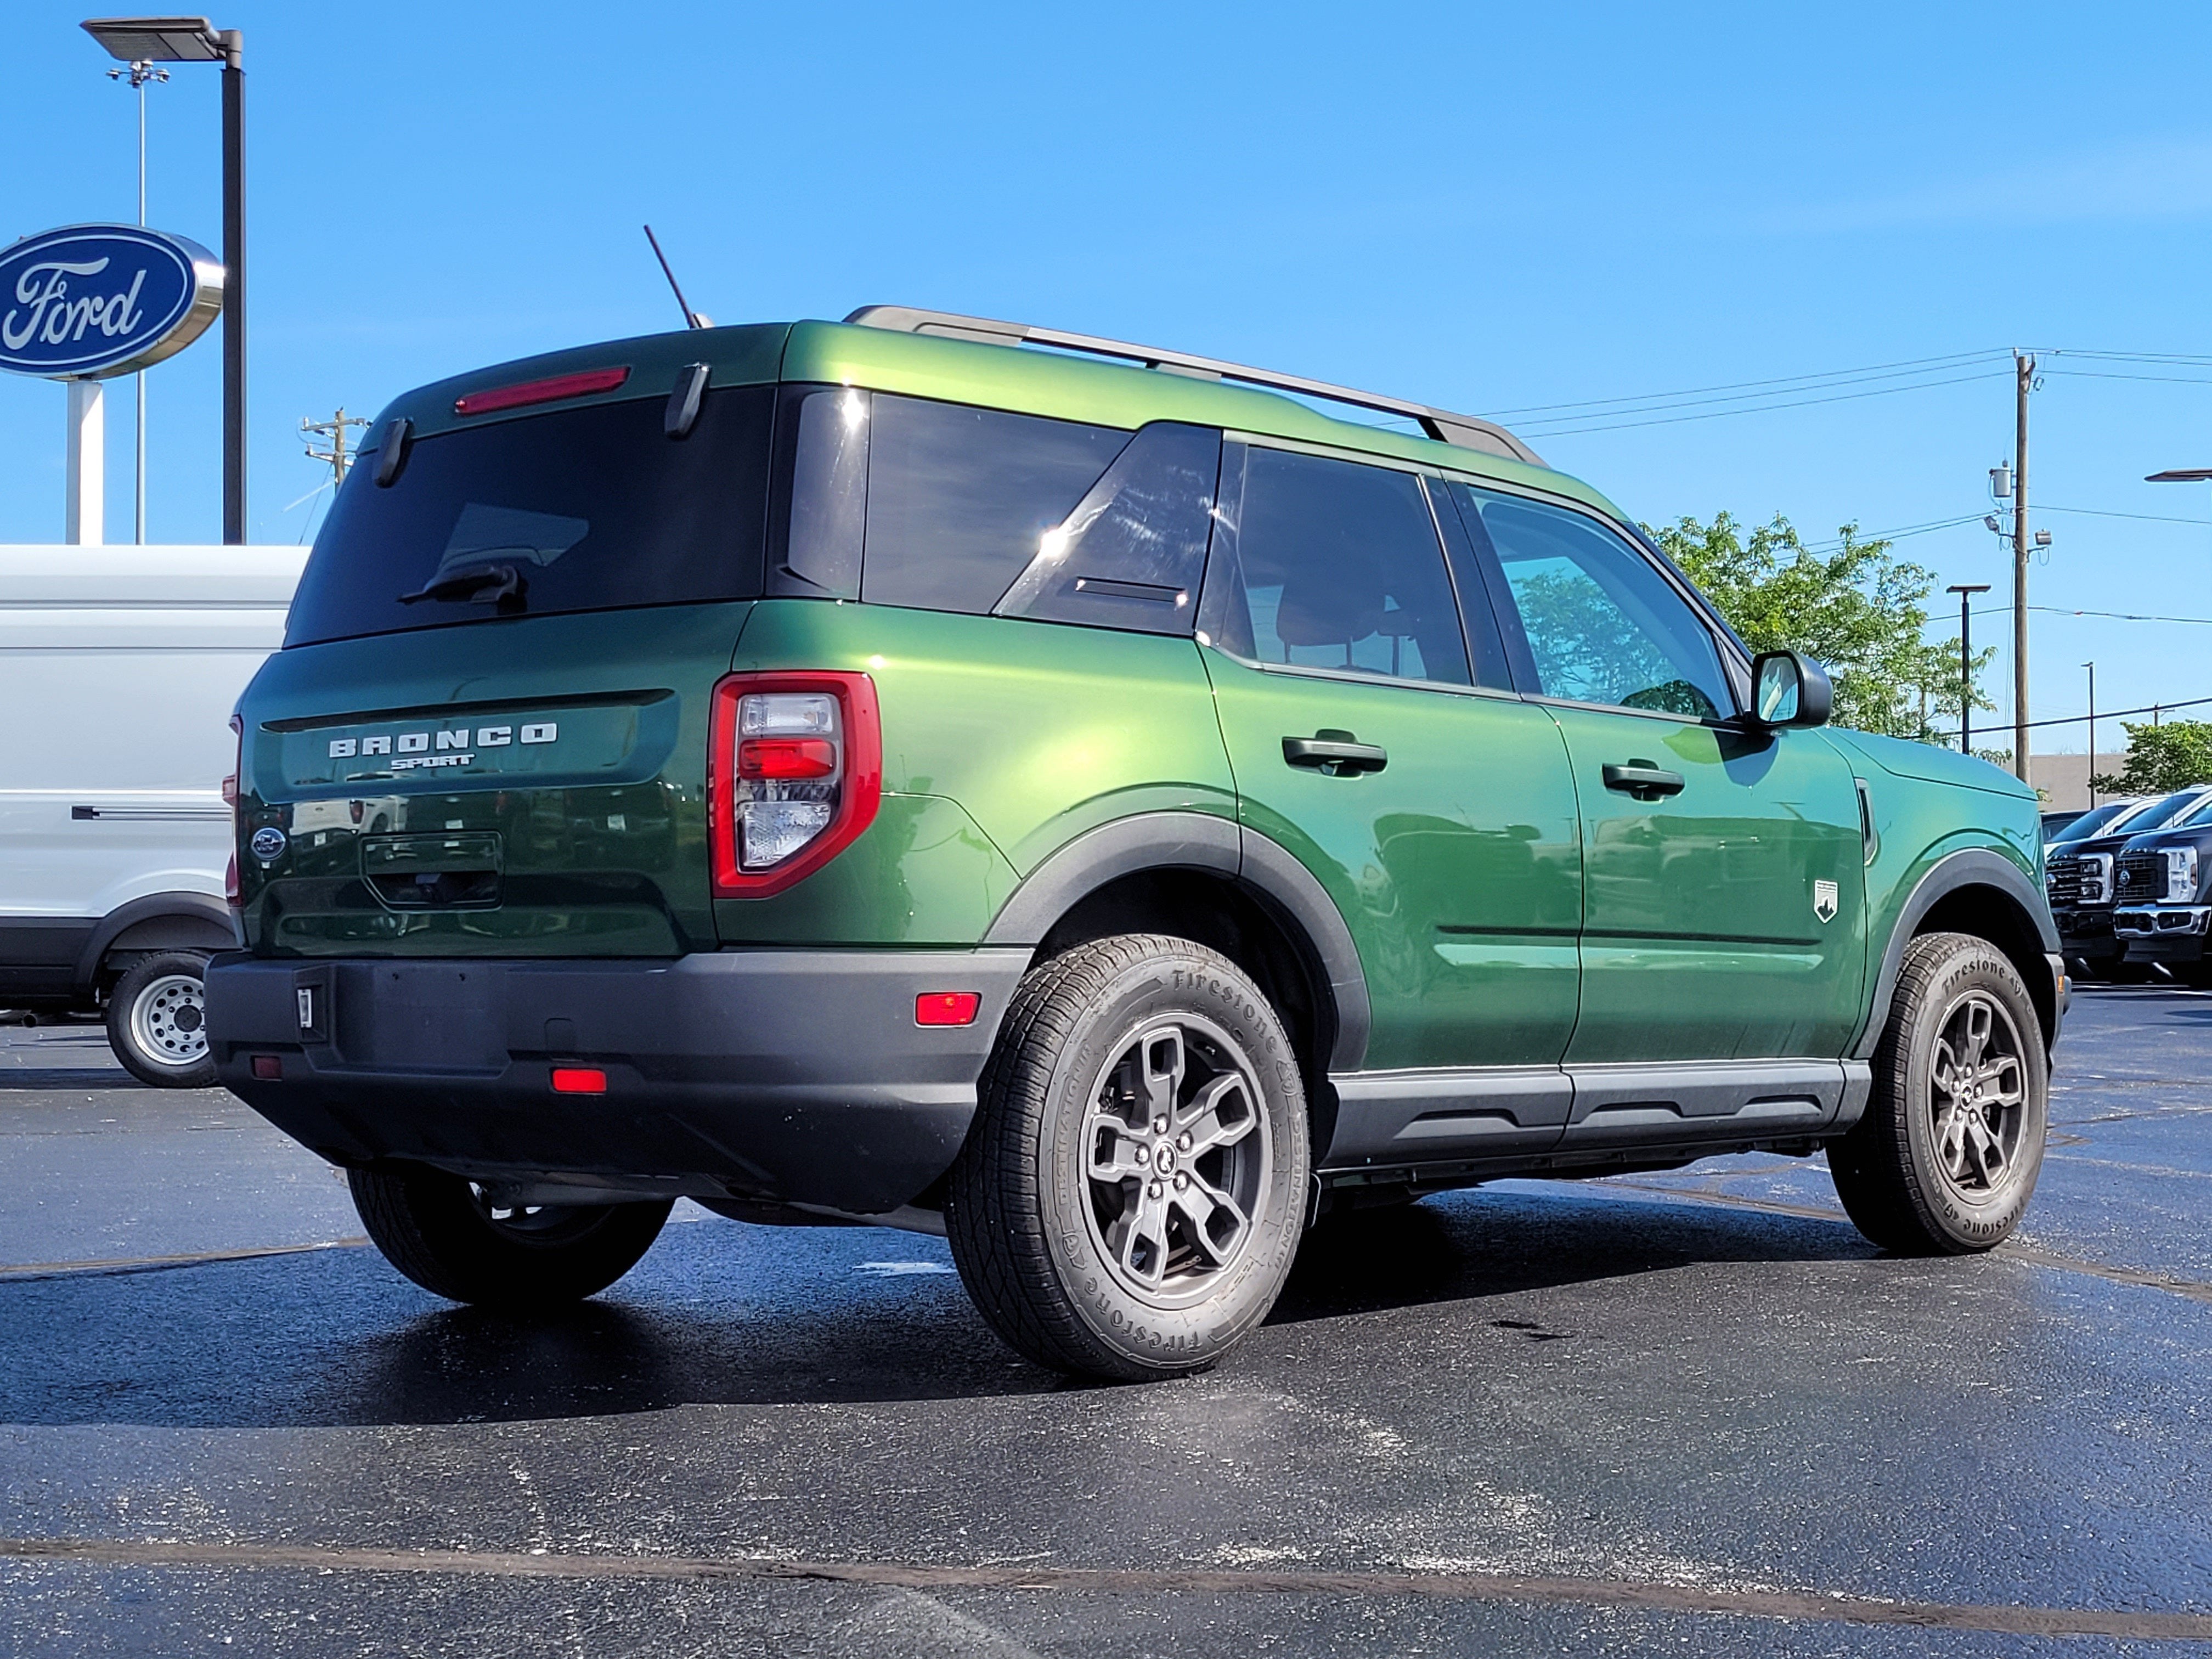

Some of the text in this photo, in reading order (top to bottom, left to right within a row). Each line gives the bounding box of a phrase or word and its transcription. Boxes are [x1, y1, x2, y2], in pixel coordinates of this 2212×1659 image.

[2, 257, 147, 350] Ford
[329, 723, 558, 758] BRONCO
[390, 753, 475, 771] SPORT
[1942, 960, 2005, 996] Firestone
[1171, 969, 1278, 1054] Firestone
[1084, 1277, 1204, 1353] Firestone
